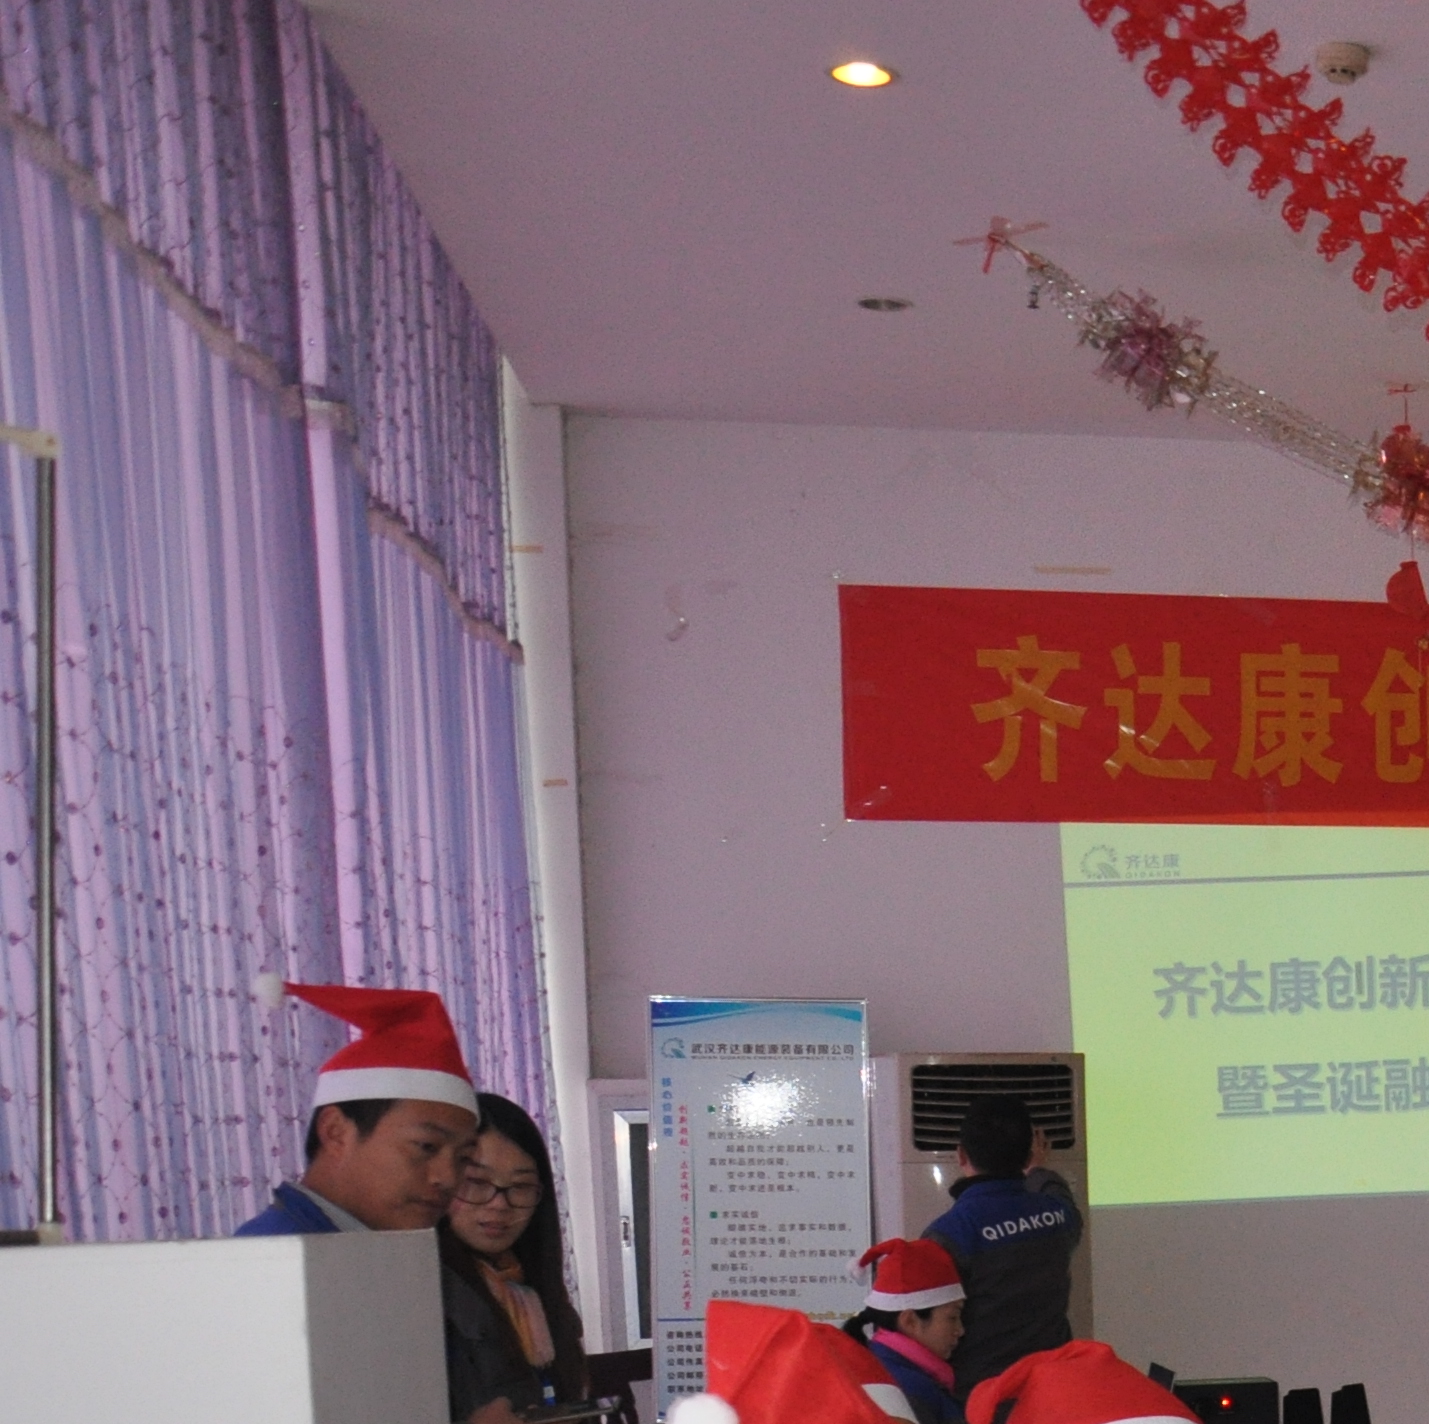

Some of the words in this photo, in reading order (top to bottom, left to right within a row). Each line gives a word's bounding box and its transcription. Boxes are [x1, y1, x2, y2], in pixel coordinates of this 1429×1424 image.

[1125, 853, 1179, 869] 齐达康
[691, 1043, 855, 1055] 武汉齐达康能源装备有限公司
[982, 1210, 1065, 1240] QIDAKON
